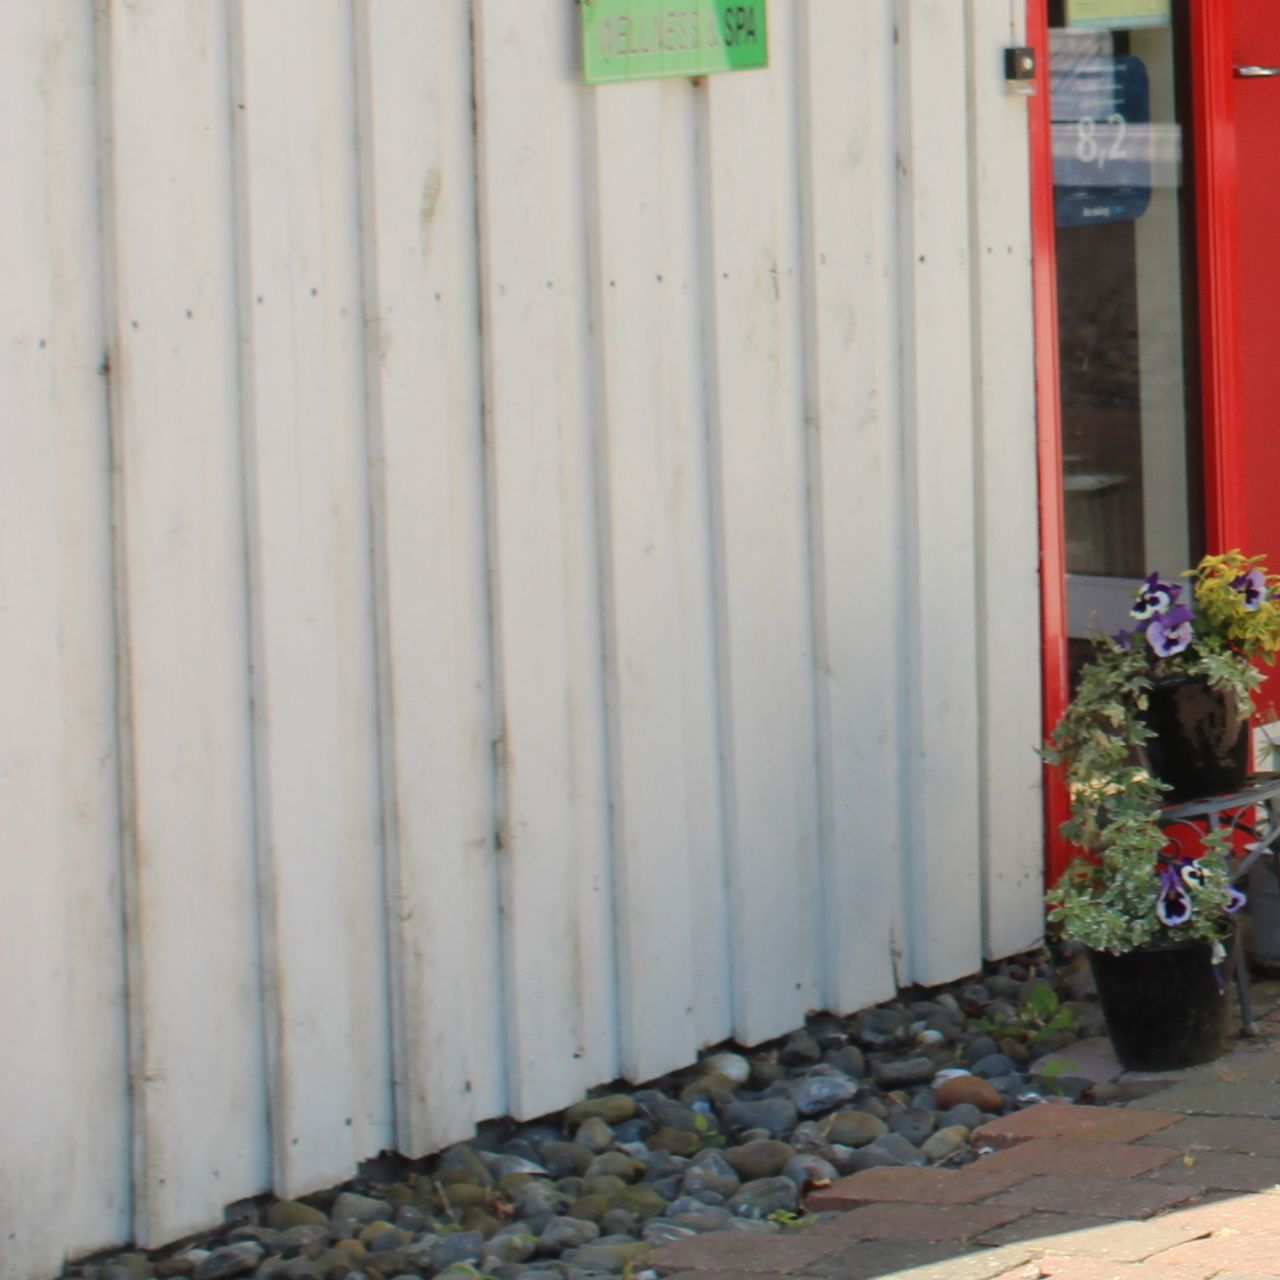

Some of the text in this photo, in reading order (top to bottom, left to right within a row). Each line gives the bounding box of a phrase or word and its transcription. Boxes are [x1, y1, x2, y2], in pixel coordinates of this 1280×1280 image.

[600, 10, 701, 62] WELLNESS
[724, 5, 757, 48] SPA
[1077, 113, 1128, 170] 8,2
